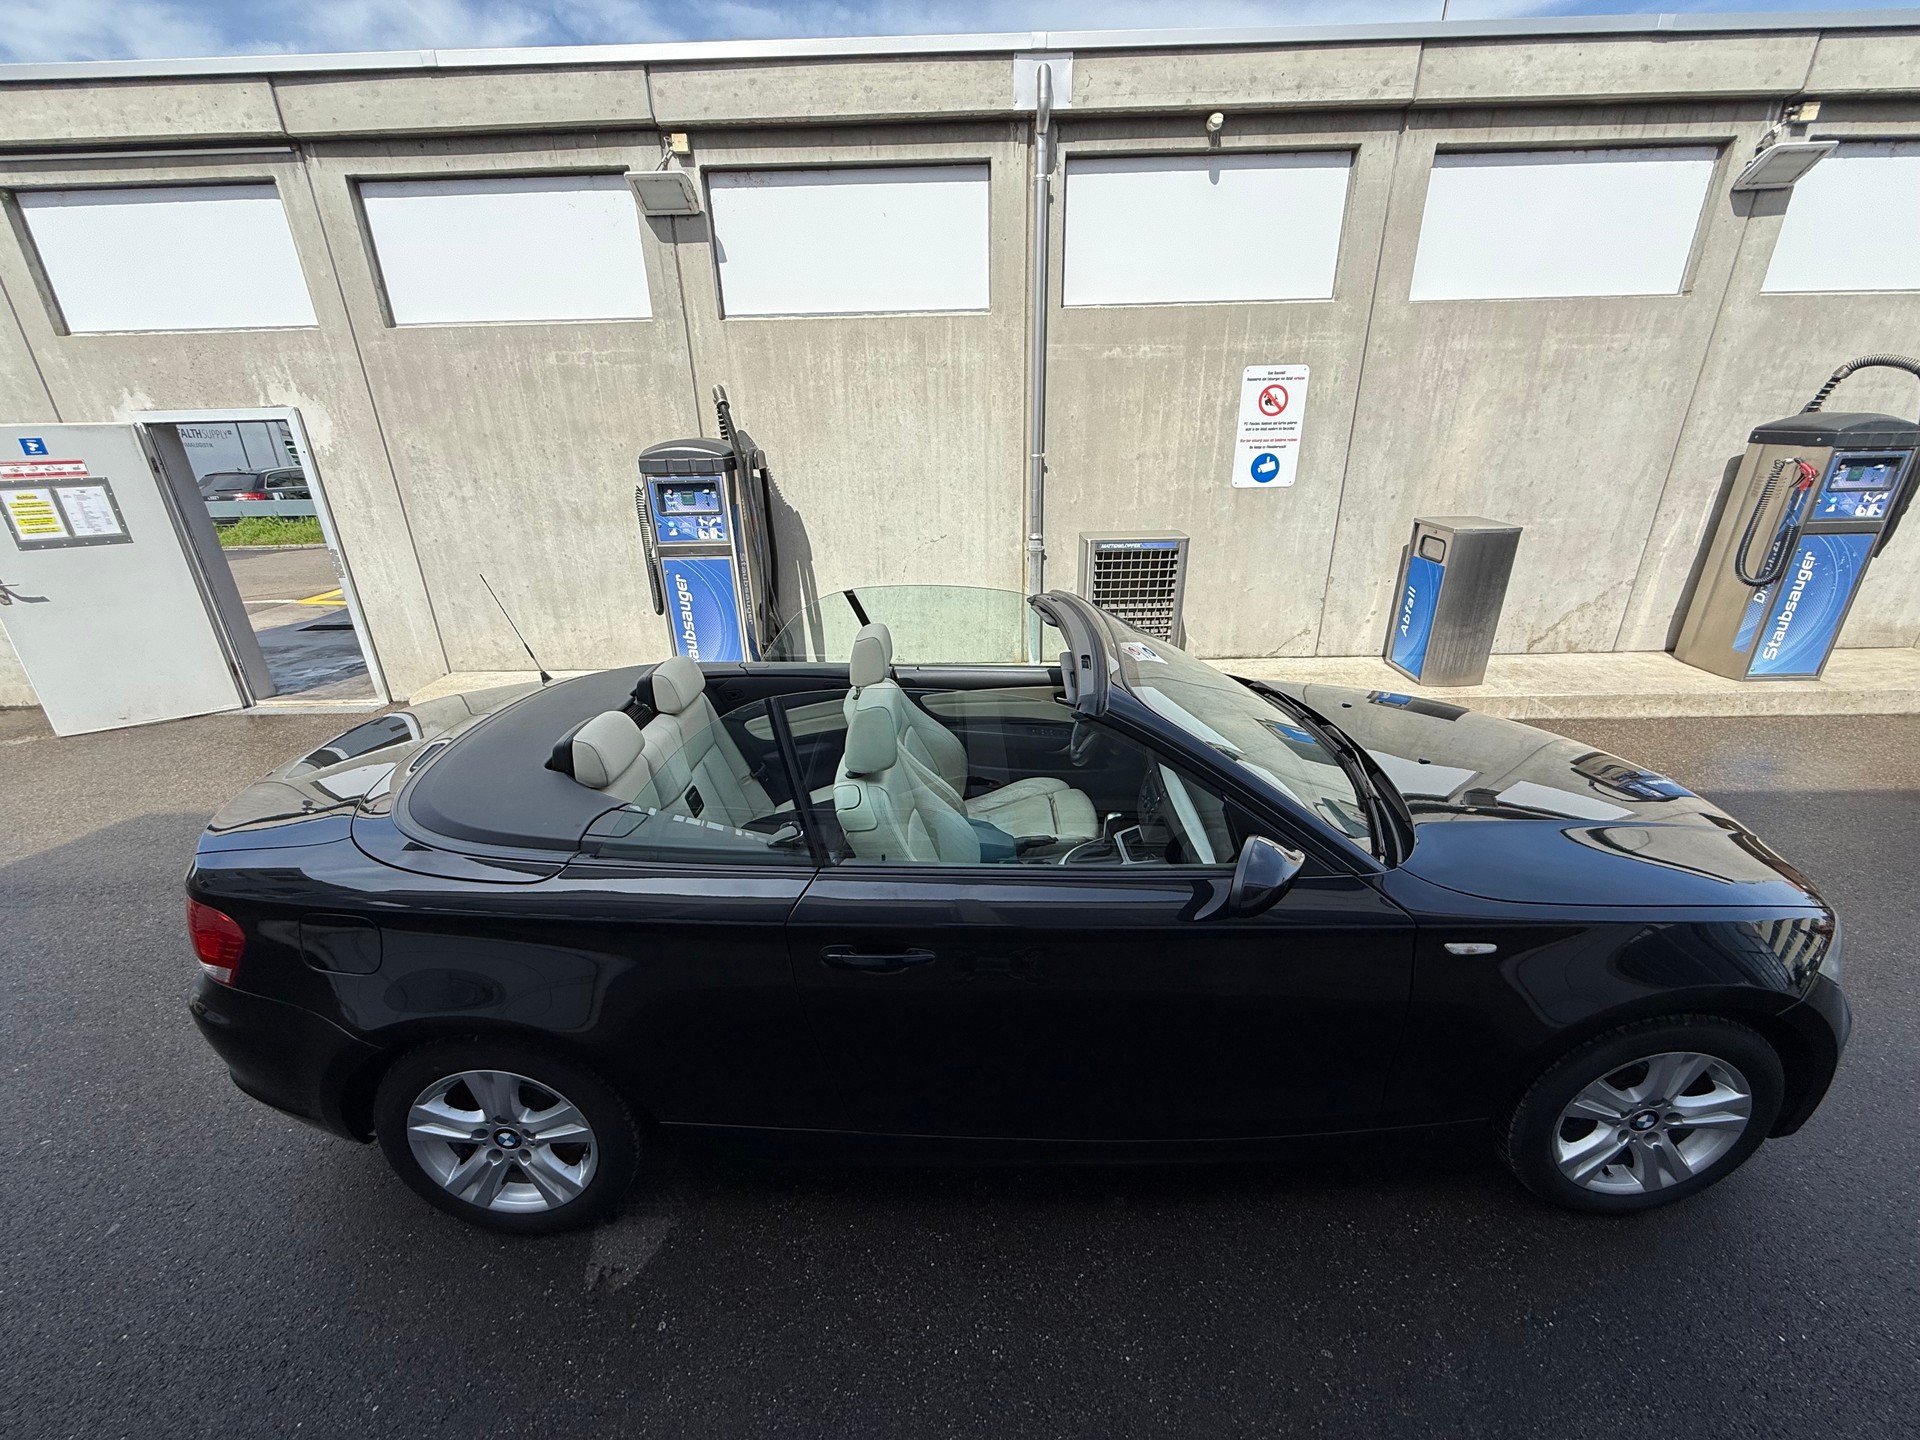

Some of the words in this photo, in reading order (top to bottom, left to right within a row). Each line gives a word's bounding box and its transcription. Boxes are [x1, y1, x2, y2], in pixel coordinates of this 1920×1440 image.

[178, 428, 228, 439] ALTHSUPPLY
[675, 573, 700, 662] aubsauger
[1400, 585, 1417, 637] Abfall
[1762, 551, 1816, 661] Staubsauger
